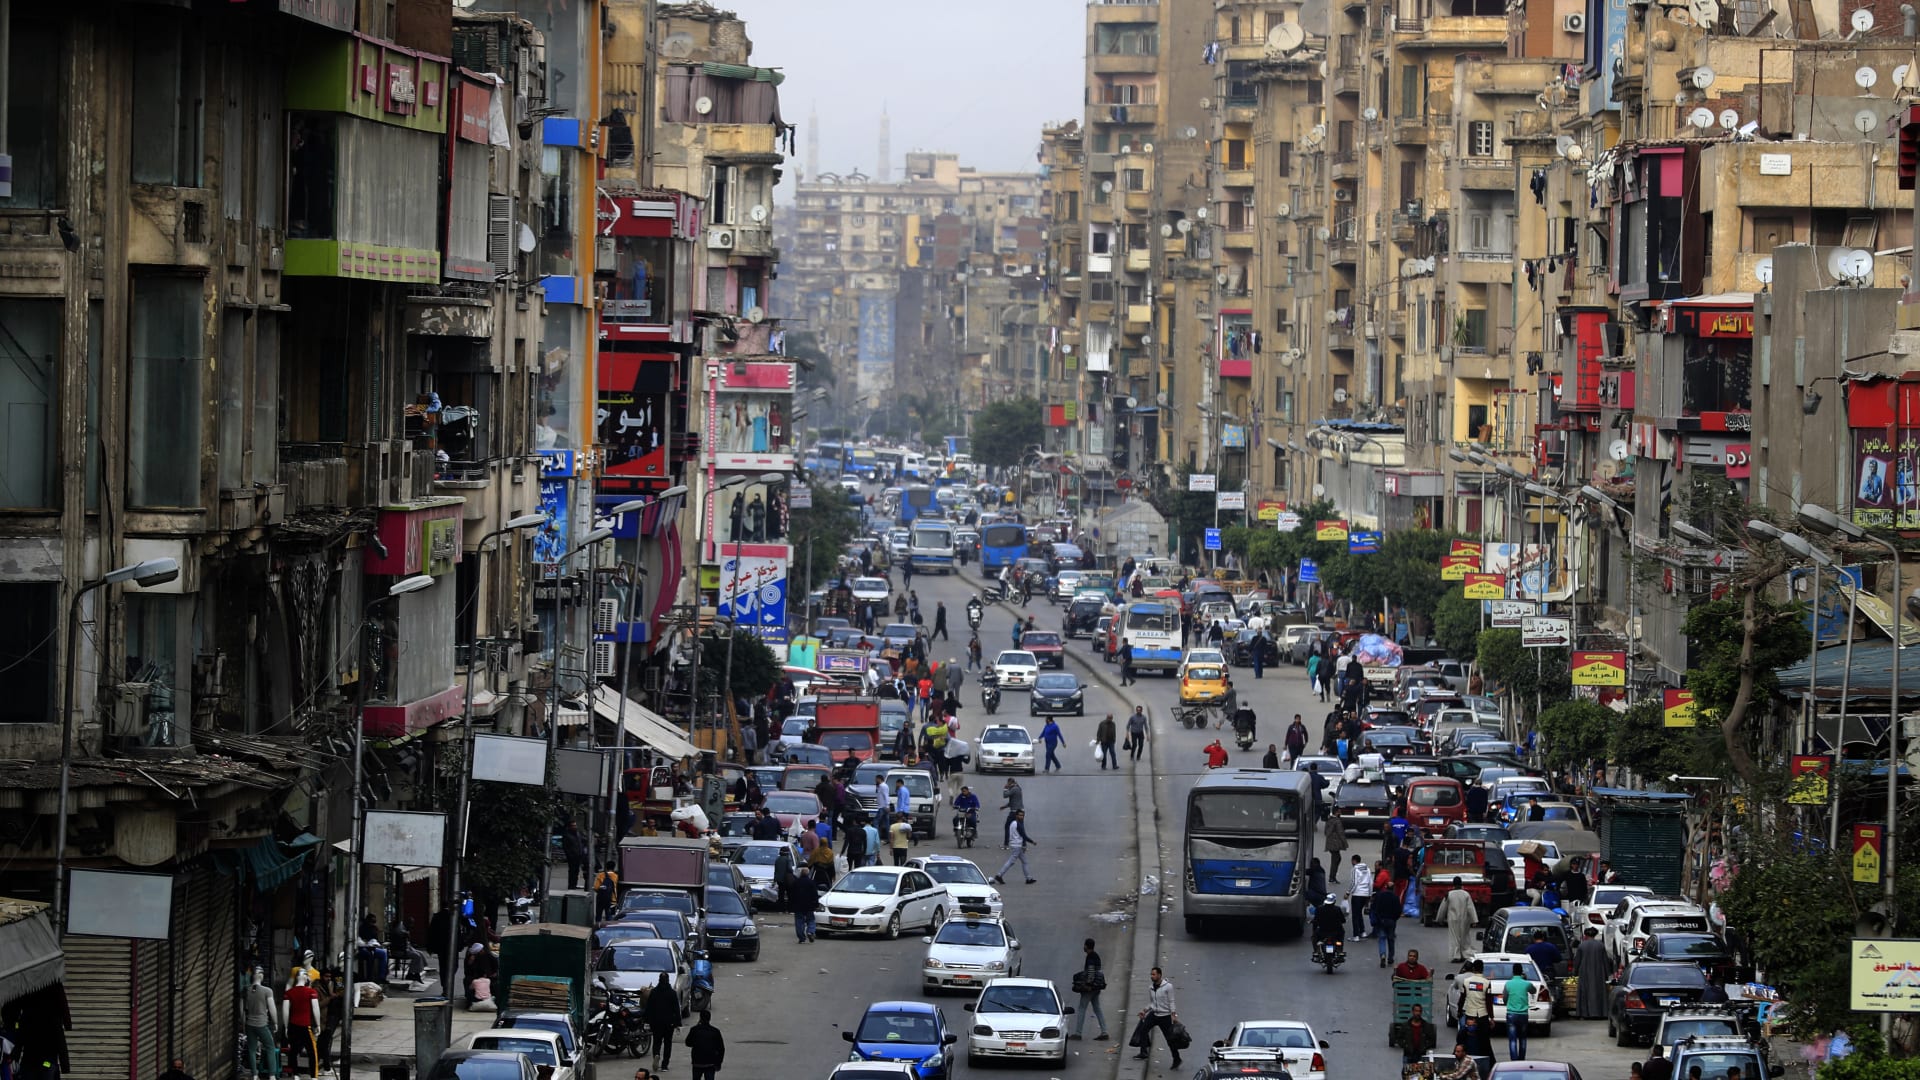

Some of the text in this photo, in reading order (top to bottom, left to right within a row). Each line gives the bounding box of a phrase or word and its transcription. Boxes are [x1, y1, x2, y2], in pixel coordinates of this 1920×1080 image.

[1710, 316, 1742, 335] الشام
[615, 396, 653, 435] أبو
[1493, 605, 1535, 617] أشرف راغب
[1523, 625, 1546, 635] راغب
[1546, 623, 1569, 634] أشرف
[1577, 669, 1619, 679] العروسة
[1873, 961, 1906, 972] الشروق
